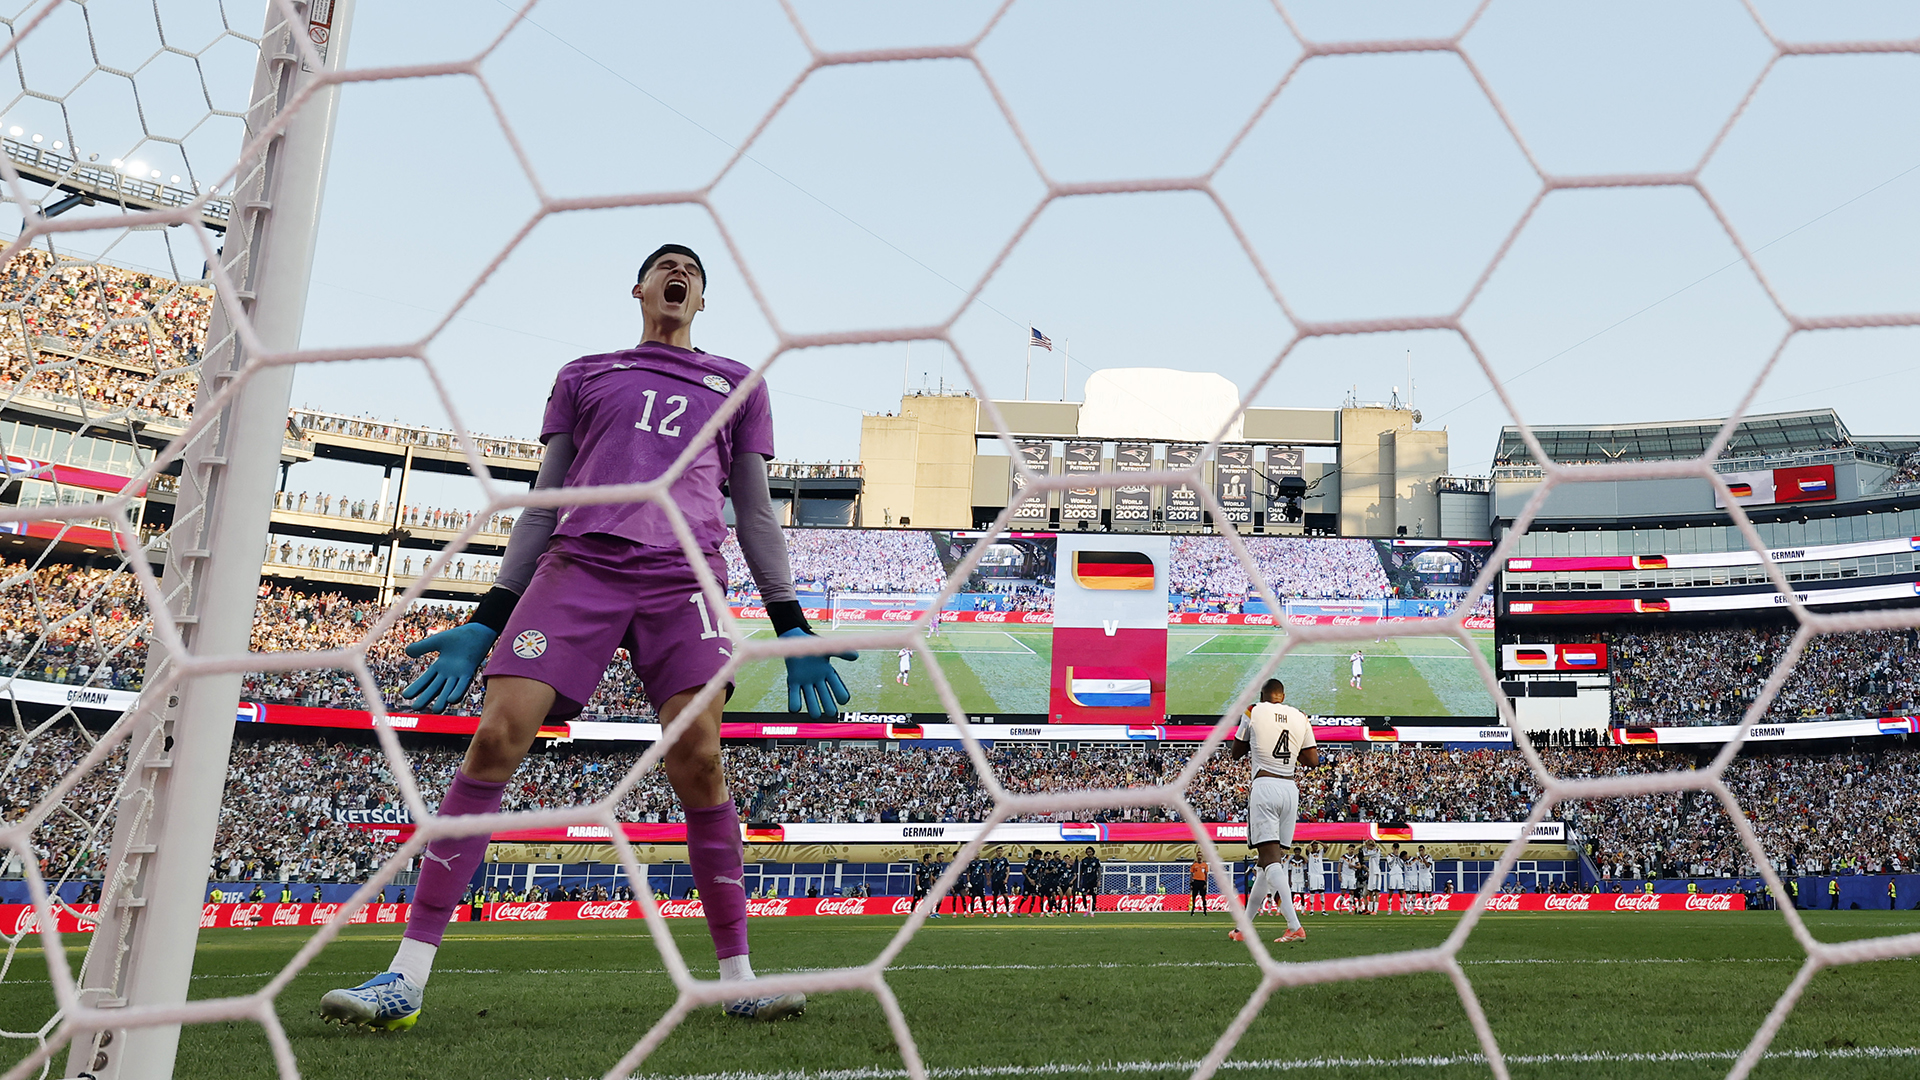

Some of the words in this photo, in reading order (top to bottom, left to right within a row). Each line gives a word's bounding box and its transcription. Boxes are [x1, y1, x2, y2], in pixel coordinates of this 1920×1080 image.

[634, 389, 689, 437] 12
[1014, 508, 1044, 517] 2001
[1064, 509, 1097, 518] 2003
[1115, 511, 1148, 519] 2004
[1168, 511, 1198, 520] 2014
[1220, 513, 1248, 521] 2016
[1772, 550, 1805, 560] GERMANY
[1509, 560, 1532, 569] AGUAY
[1510, 603, 1533, 612] AGUAY
[975, 611, 1008, 622] Coca-Cola
[1198, 613, 1229, 624] Coca-Cola
[1244, 614, 1274, 624] Coca-Cola
[372, 715, 419, 728] PRAGUAY
[844, 712, 906, 723] Hisense
[1274, 713, 1288, 723] TAH
[762, 726, 798, 735] PARAGUAY
[1010, 728, 1041, 737] GERMANY
[1479, 730, 1509, 738] GERMANY
[1750, 727, 1785, 737] GERMANY
[1272, 729, 1291, 764] 4
[336, 808, 410, 823] KETSCH
[903, 827, 944, 838] GERMANY
[815, 898, 868, 915] Coca-Cola
[1544, 894, 1592, 910] Coca-Cola
[1615, 894, 1662, 910] Coca-Cola
[1685, 894, 1733, 910] Coca-Cola
[272, 904, 303, 925] Coca-Cola
[376, 903, 398, 922] Coca-Cola
[495, 901, 552, 920] Coca-Cola
[577, 900, 633, 919] Coca-Cola
